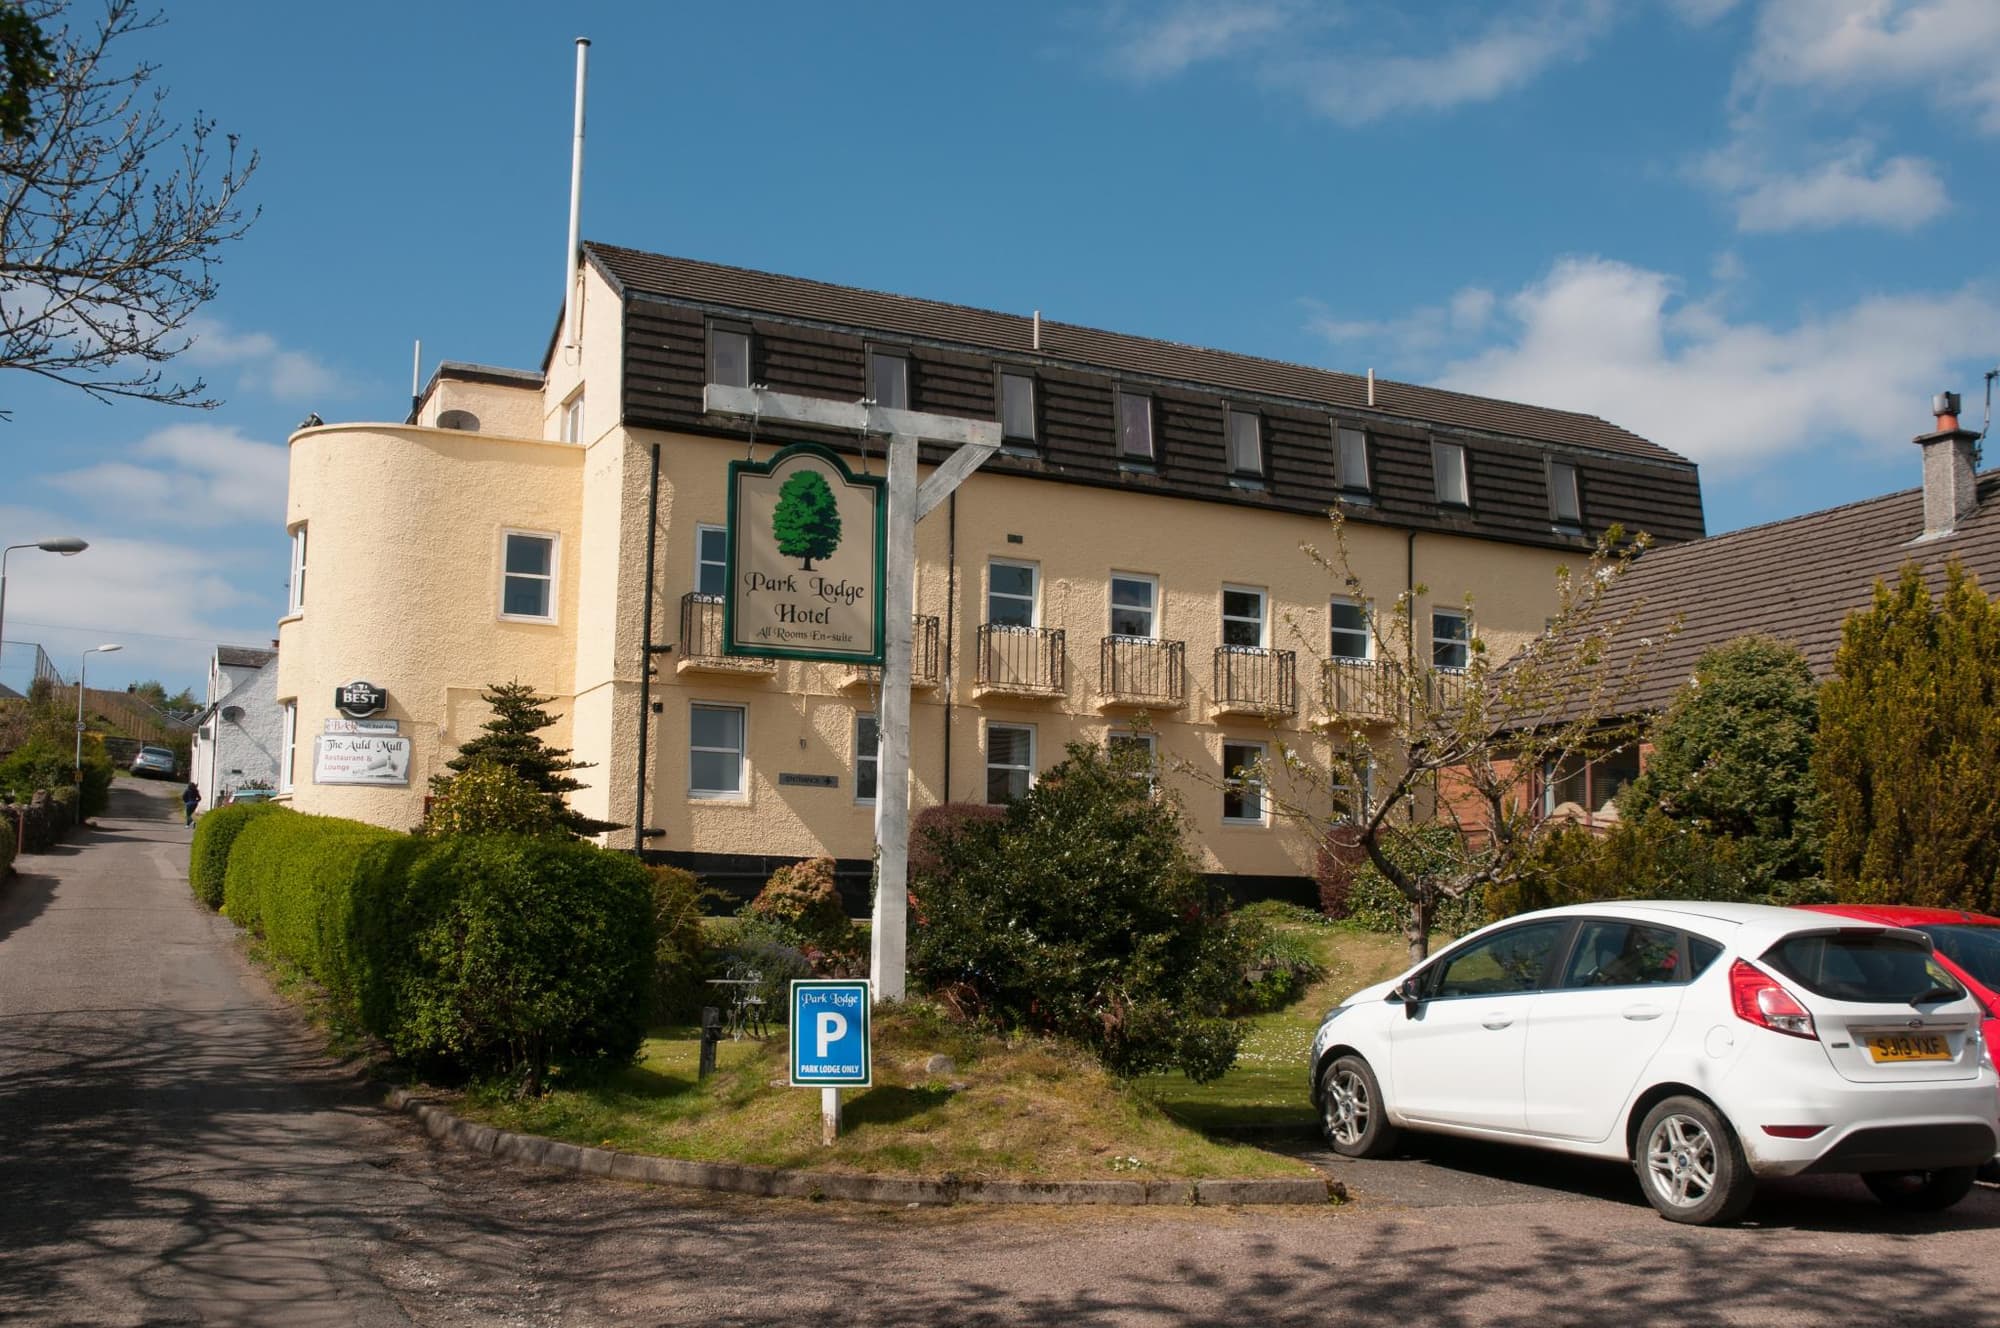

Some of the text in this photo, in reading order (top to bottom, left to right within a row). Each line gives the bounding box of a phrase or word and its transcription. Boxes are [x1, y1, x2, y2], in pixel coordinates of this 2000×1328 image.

[744, 572, 864, 604] Park Lodge
[775, 604, 831, 624] Hotel
[756, 626, 853, 642] All Rooms En-suite
[343, 691, 378, 703] BEST
[326, 739, 402, 753] The Auld Mull
[324, 764, 350, 772] Lounge
[801, 993, 859, 1008] Park Lodge
[816, 1011, 848, 1057] P
[1877, 1039, 1910, 1056] SJ13
[801, 1064, 859, 1073] PARK LODGE ONLY
